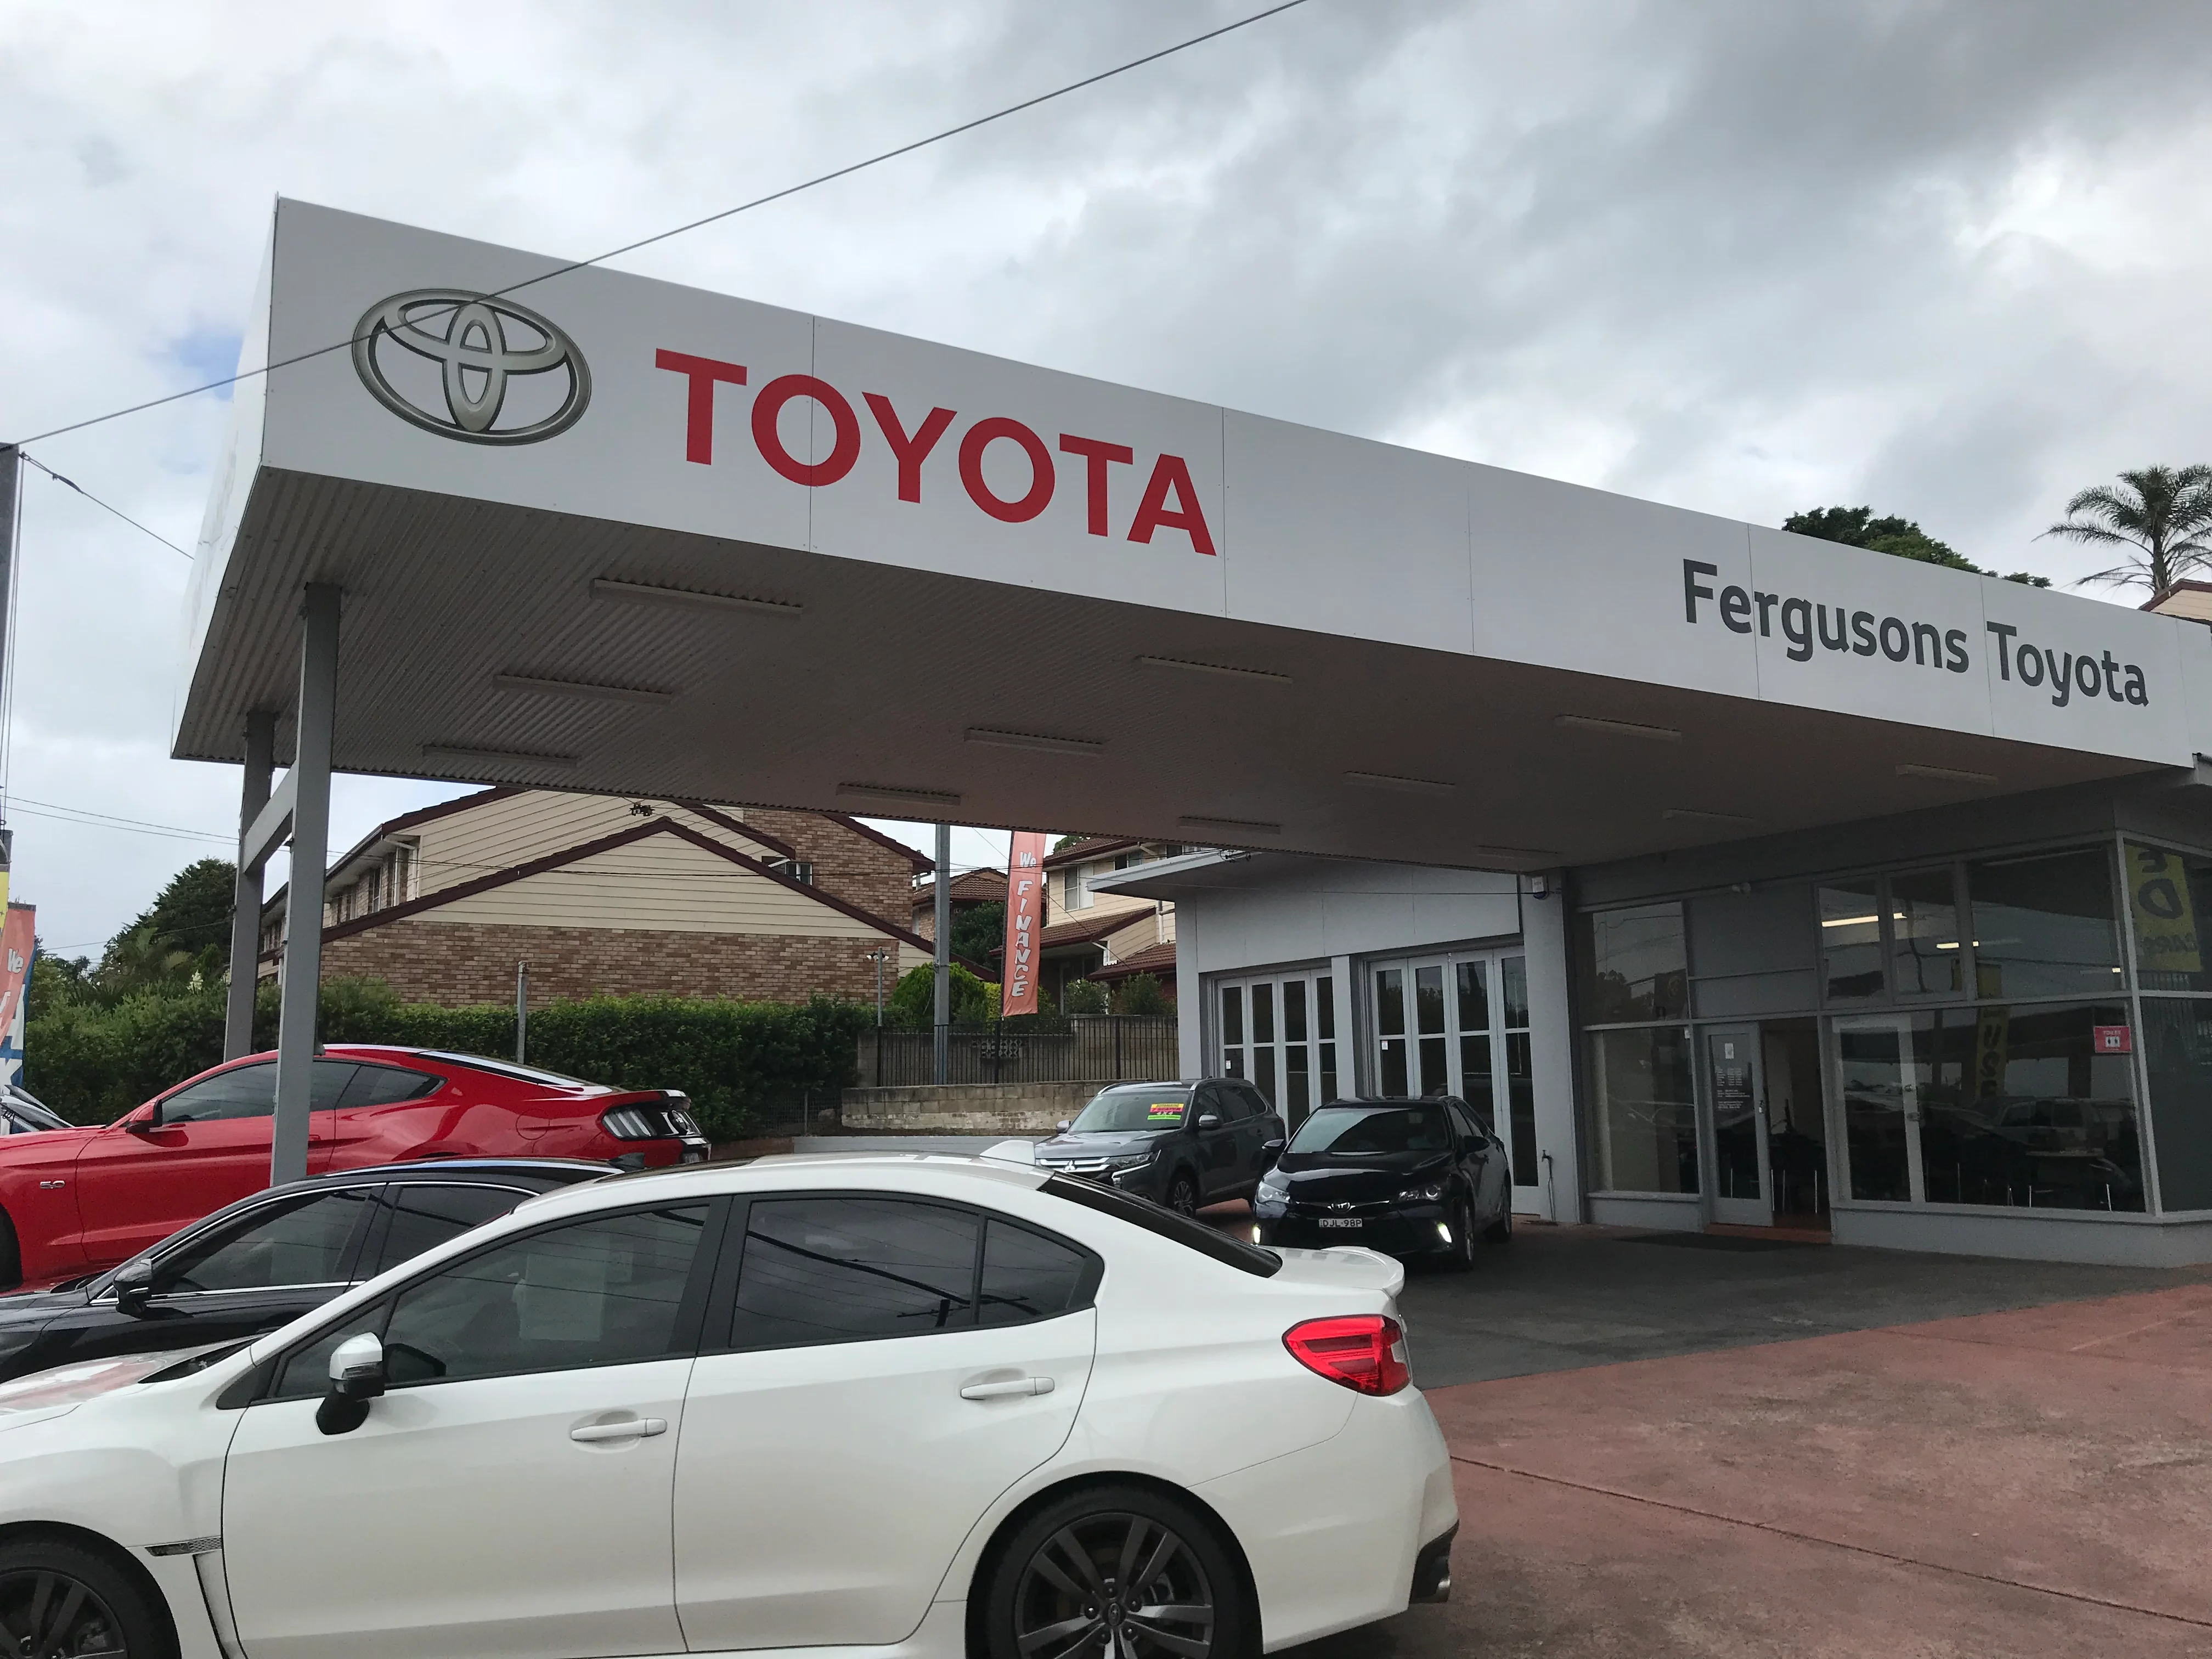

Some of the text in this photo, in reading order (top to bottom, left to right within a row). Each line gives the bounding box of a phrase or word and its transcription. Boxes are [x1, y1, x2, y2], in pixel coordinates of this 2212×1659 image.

[656, 348, 1216, 556] TOYOTA
[1683, 558, 2148, 707] Fergusons Toyota
[1019, 851, 1036, 868] We
[7, 948, 23, 973] We
[1011, 880, 1033, 997] FINANCE
